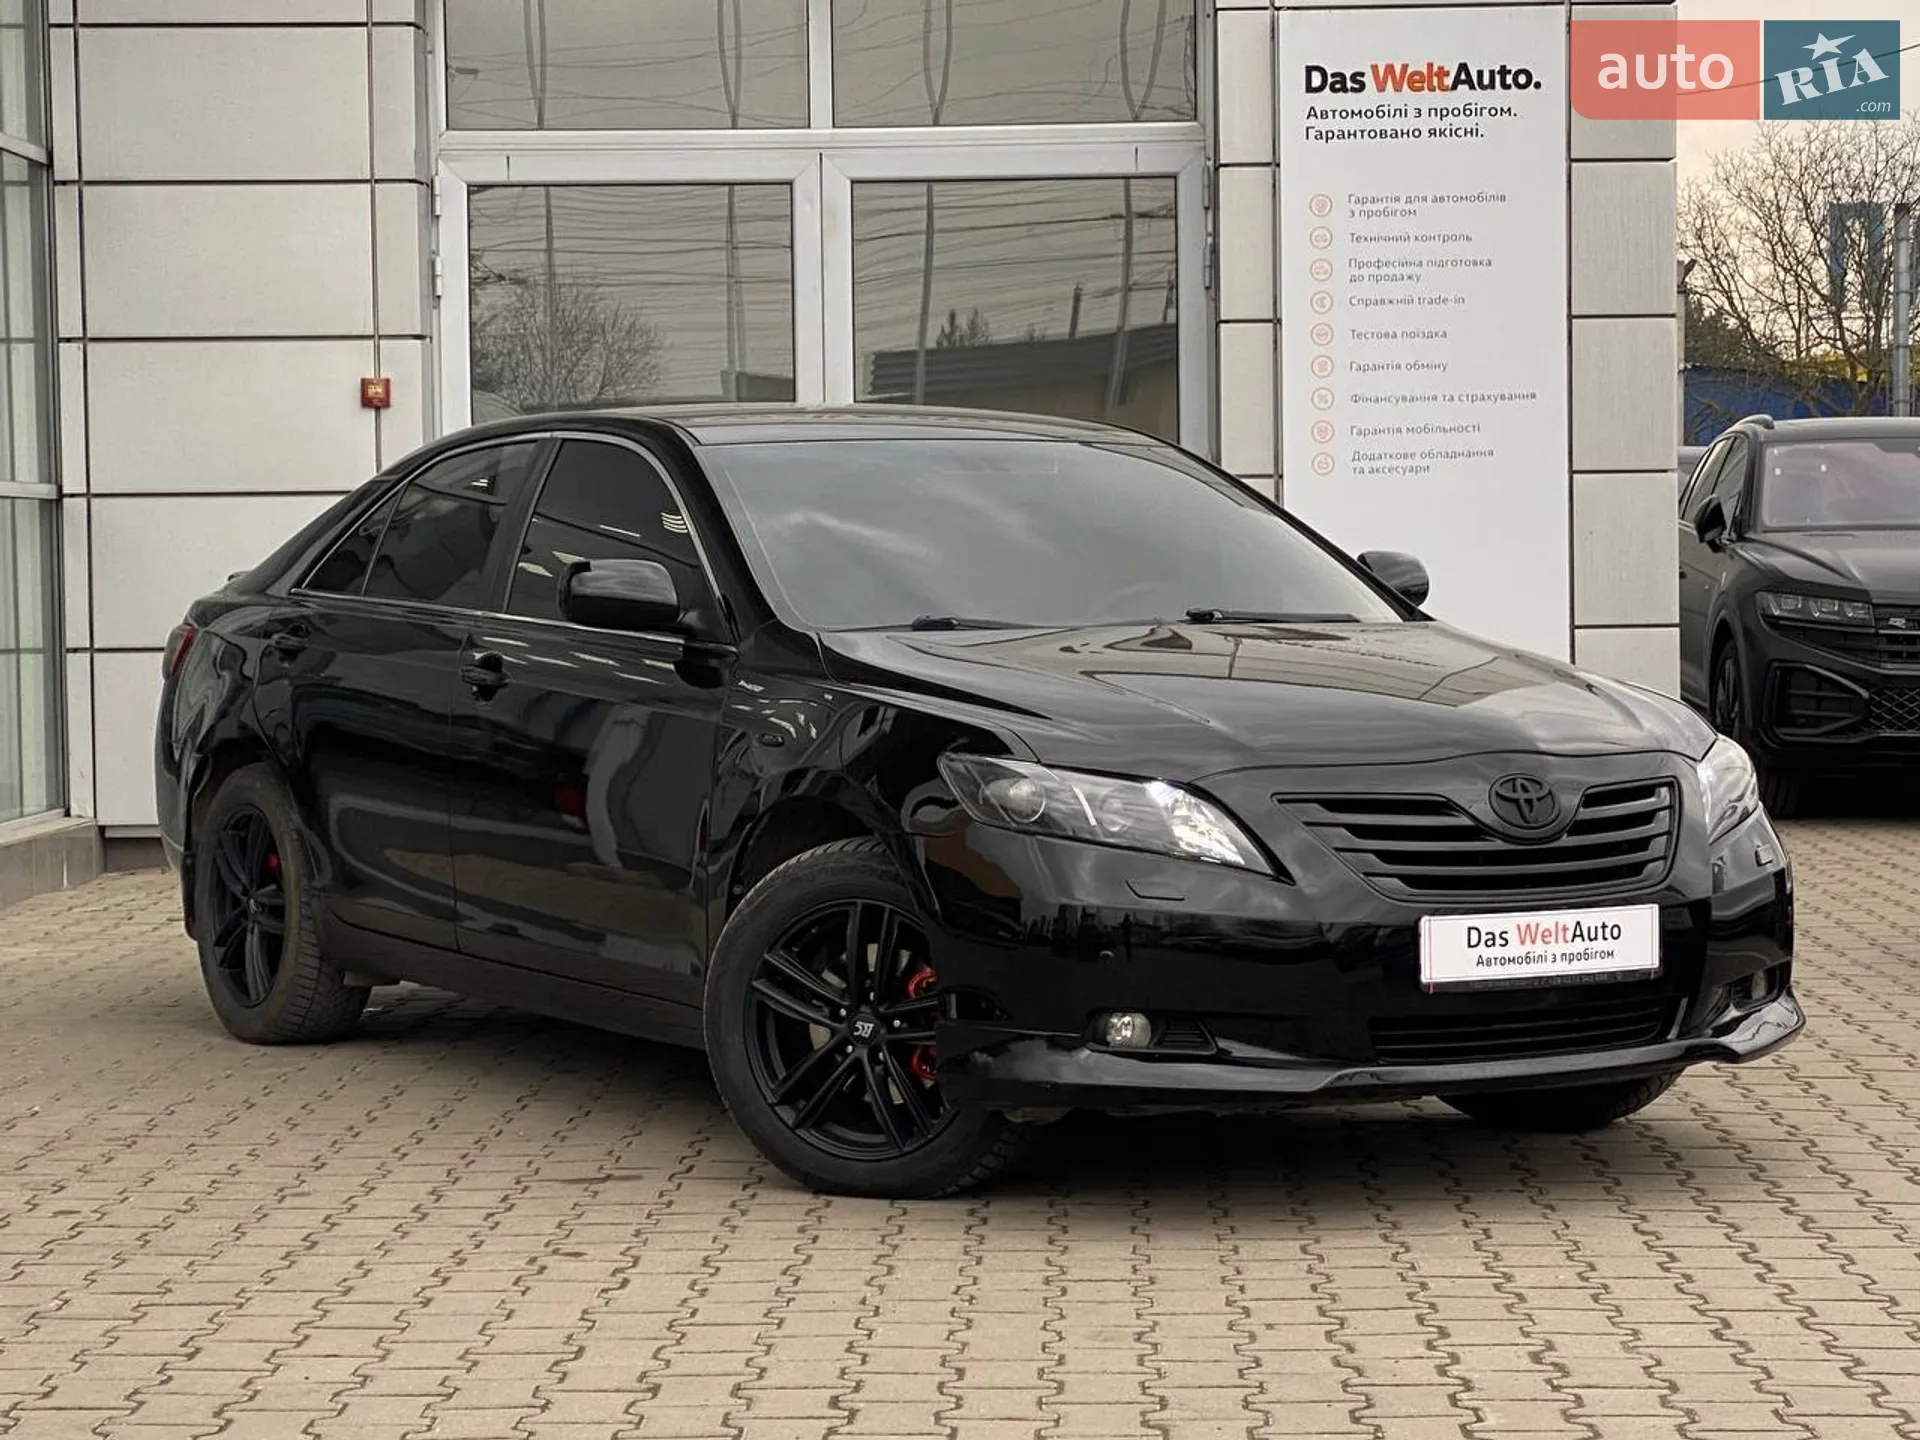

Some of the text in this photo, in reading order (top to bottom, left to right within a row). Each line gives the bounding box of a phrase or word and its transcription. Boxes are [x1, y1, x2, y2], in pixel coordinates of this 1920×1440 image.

[1305, 62, 1542, 94] Das WeltAuto.
[1306, 104, 1518, 121] Автомобілі з пробігом.
[1305, 124, 1485, 143] Гарантовано якісні.
[1348, 192, 1506, 206] Гарантія для автомобілів
[1348, 207, 1417, 219] з пробігом
[1350, 233, 1473, 245] Технічний контроль
[1348, 257, 1492, 270] Професійна підготовка
[1349, 273, 1422, 284] до продажу
[1349, 295, 1465, 308] Справжній trade-in
[1350, 329, 1397, 340] Тестова
[1350, 361, 1448, 373] Гарантія обміну
[1351, 391, 1537, 405] Фінансування та страхування
[1350, 423, 1481, 437] Гарантія мобільності
[1351, 448, 1494, 463] Додаткове обладнання
[1352, 464, 1430, 476] та аксесуари
[1467, 920, 1622, 949] Das WeltAuto
[1476, 947, 1614, 967] Автомобілі з пробігом
